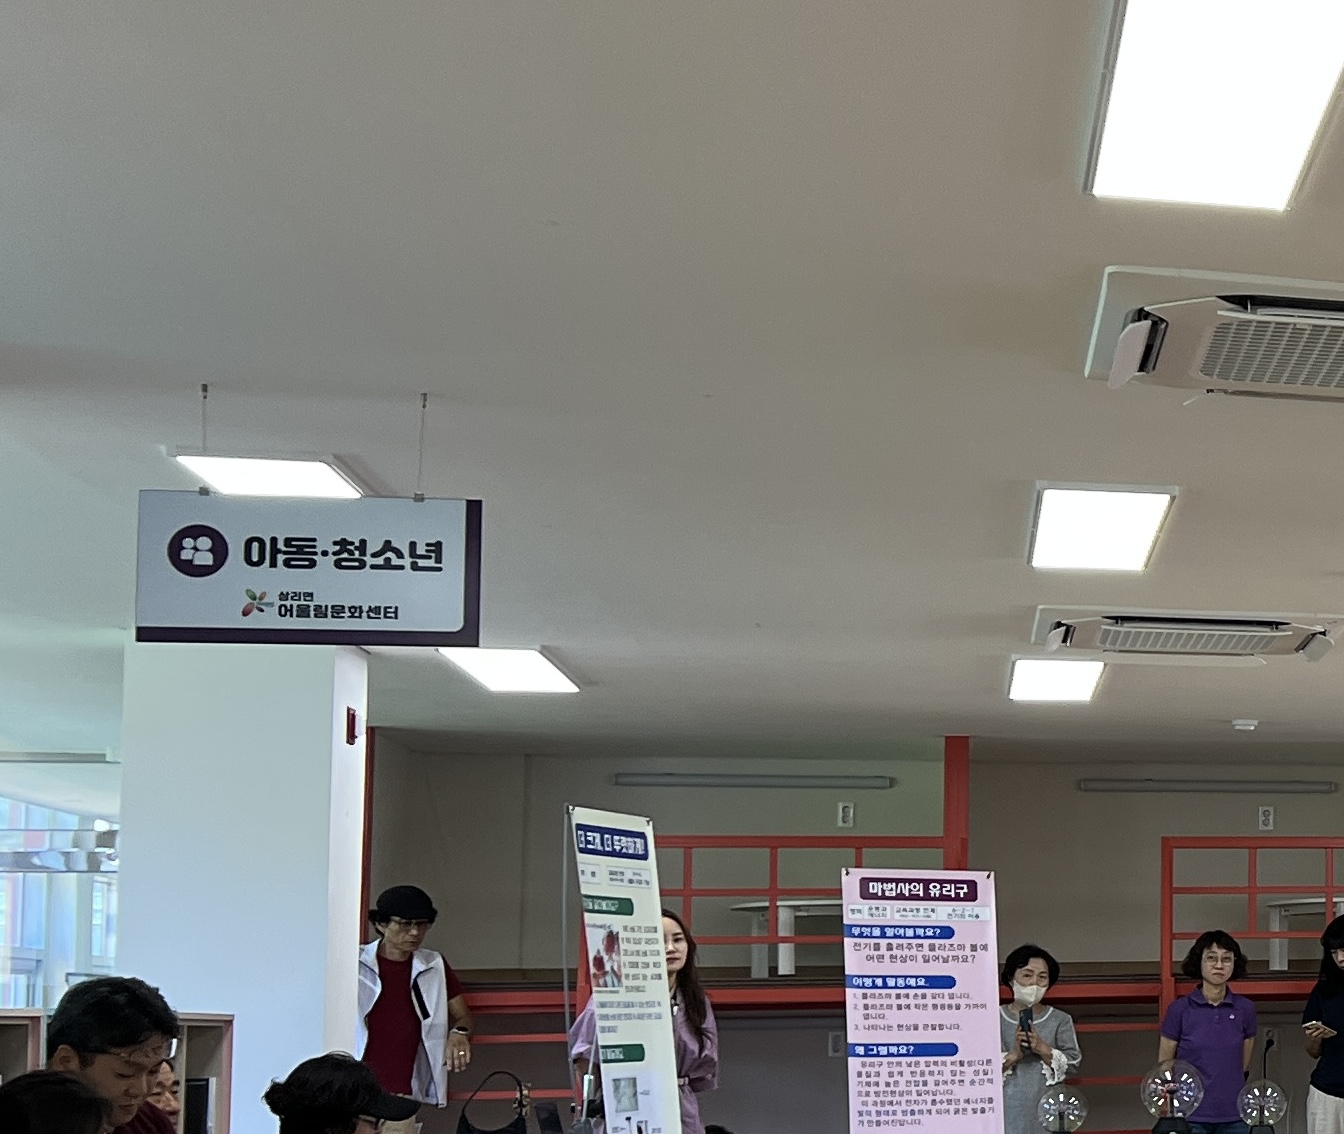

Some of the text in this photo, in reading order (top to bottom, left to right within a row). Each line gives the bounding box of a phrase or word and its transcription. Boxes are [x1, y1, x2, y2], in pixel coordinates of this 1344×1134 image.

[243, 535, 444, 573] 아동·청소년
[278, 603, 399, 620] 어울림문화센터
[869, 882, 969, 899] 마법사의 유리구
